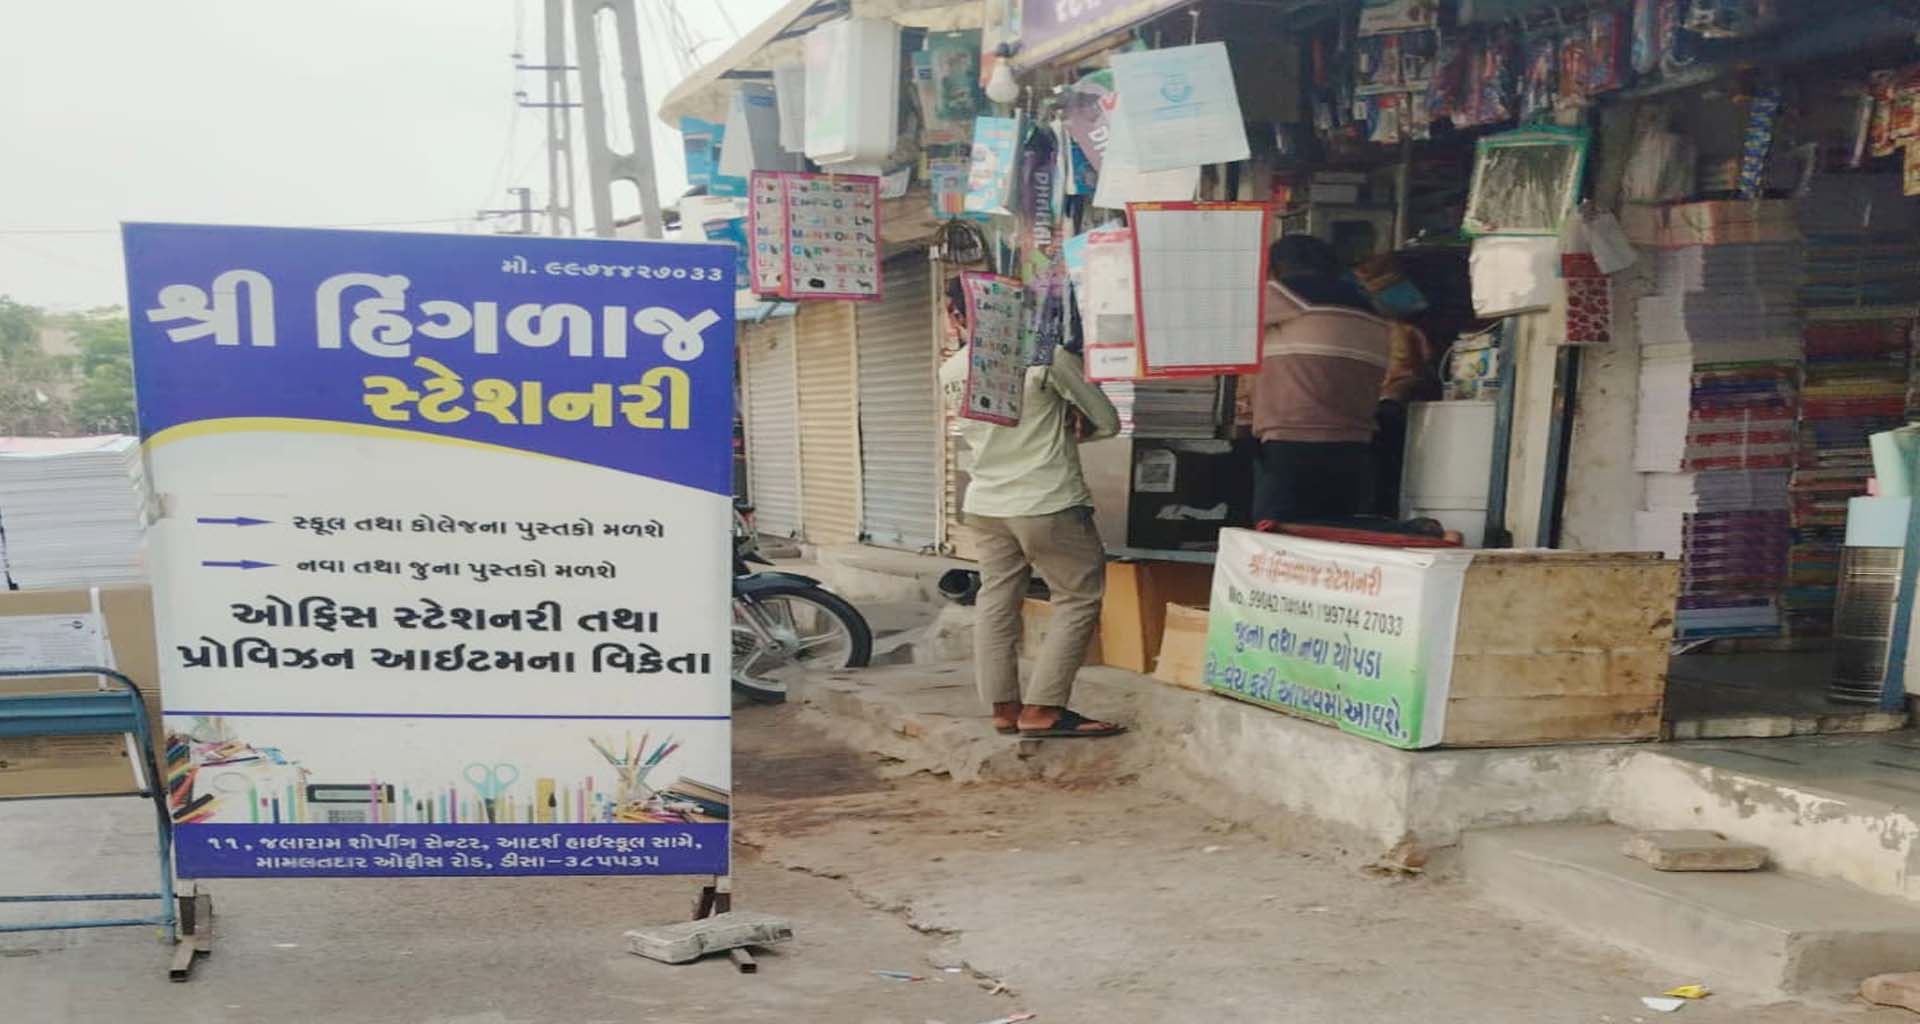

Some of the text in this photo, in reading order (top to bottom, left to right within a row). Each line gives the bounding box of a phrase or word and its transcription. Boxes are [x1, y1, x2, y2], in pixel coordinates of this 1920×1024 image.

[502, 255, 537, 275] મો.
[146, 269, 721, 361] શ્રી હિંગળાજ
[363, 356, 690, 430] સ્ટેશનરી
[293, 513, 664, 542] સ્કૂલ તથા કોલેજના પુસ્તકો મળશે
[296, 559, 616, 583] નવા તથા જુના પુસ્તકો મળશે
[231, 594, 658, 633] ઓફિસ સ્ટેશનરી તથા
[177, 635, 354, 670] પ્રોવિઝન
[259, 836, 341, 850] જલારામ
[496, 833, 561, 850] આદર્શ
[256, 856, 368, 869] મામલતદાર
[373, 852, 443, 870] ઓફીસ
[450, 852, 493, 870] રોડ,
